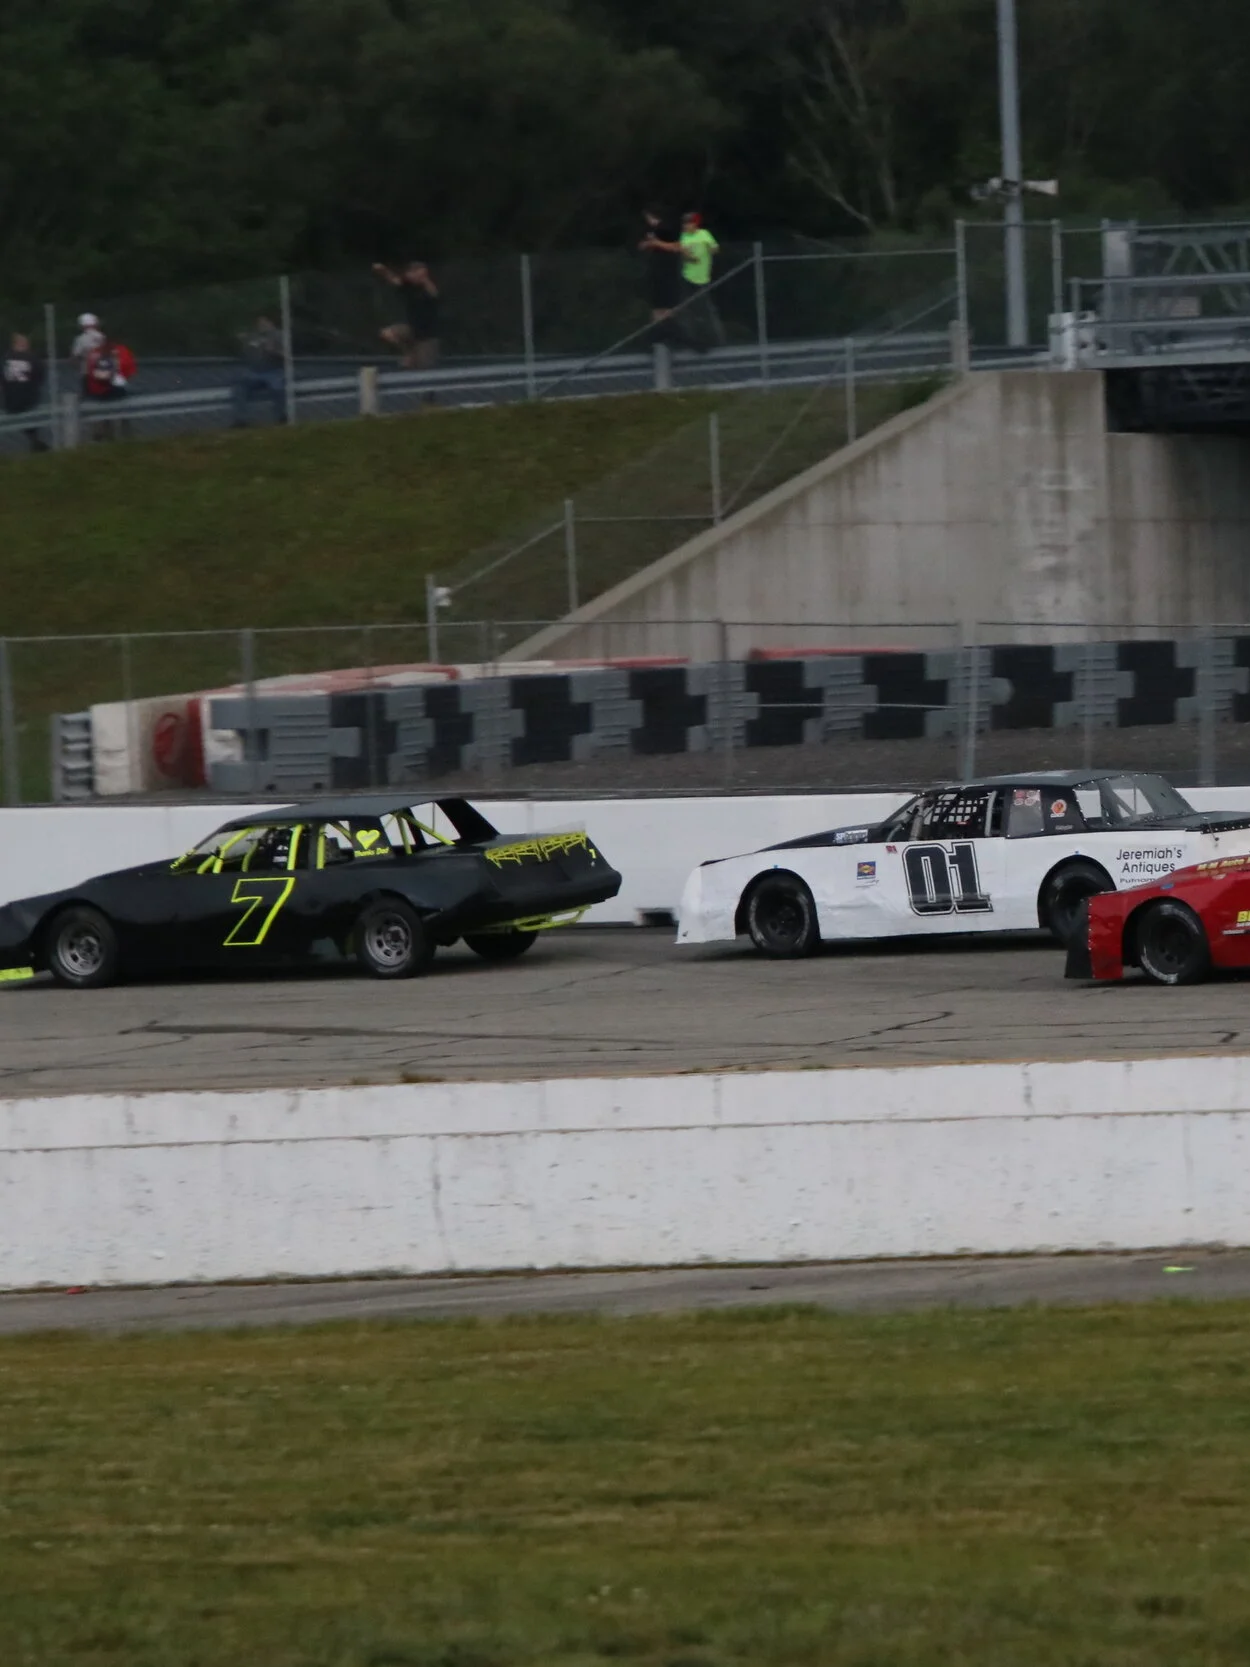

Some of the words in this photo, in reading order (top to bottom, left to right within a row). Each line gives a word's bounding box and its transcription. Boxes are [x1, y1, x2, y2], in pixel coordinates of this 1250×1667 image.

[1116, 847, 1183, 861] Jeremiah's
[1122, 861, 1176, 875] Antiques
[902, 841, 994, 916] 01
[222, 876, 296, 946] 7
